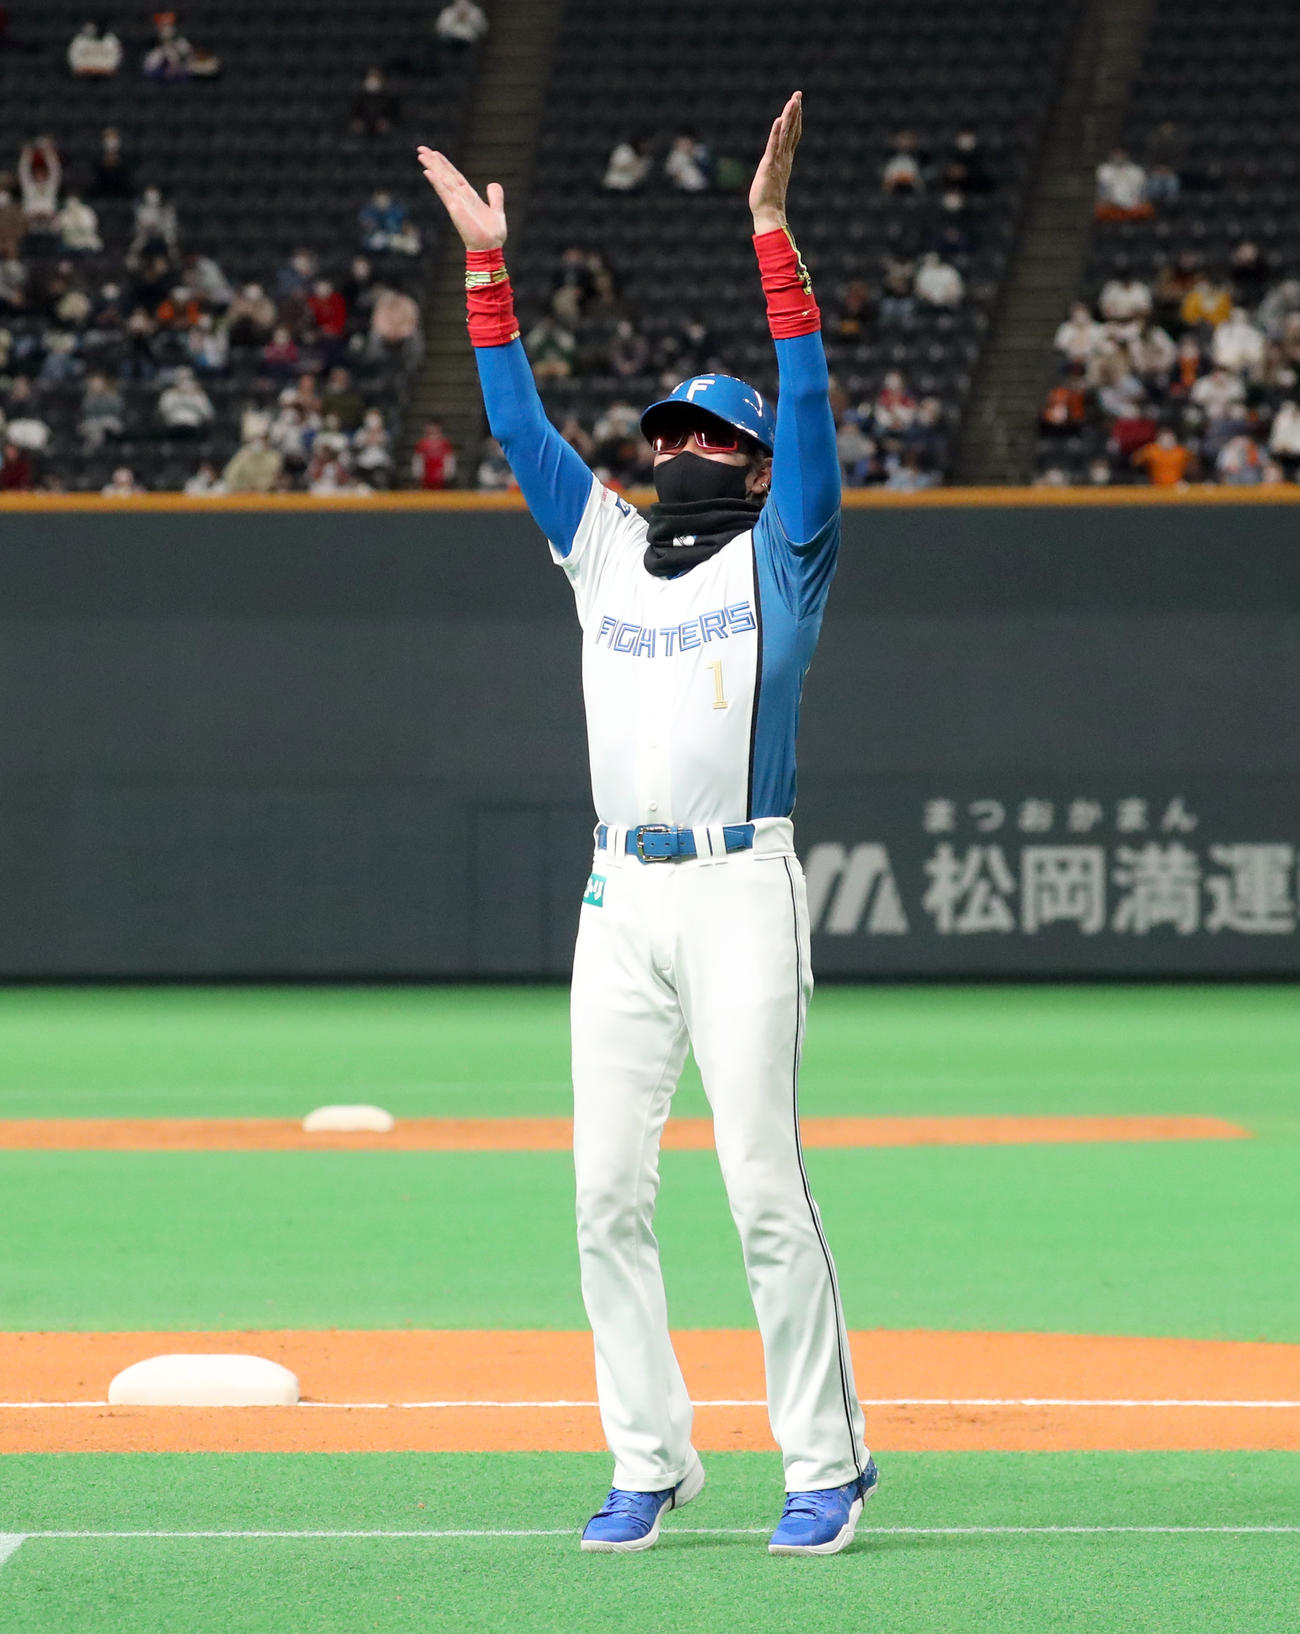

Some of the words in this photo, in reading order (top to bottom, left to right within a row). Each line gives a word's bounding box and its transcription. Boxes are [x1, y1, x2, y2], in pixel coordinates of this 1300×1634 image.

[686, 379, 716, 402] F
[596, 601, 756, 658] FIGHTERS
[706, 659, 728, 709] 1
[923, 799, 1198, 834] まつおかまん
[924, 842, 1300, 935] 松岡満運
